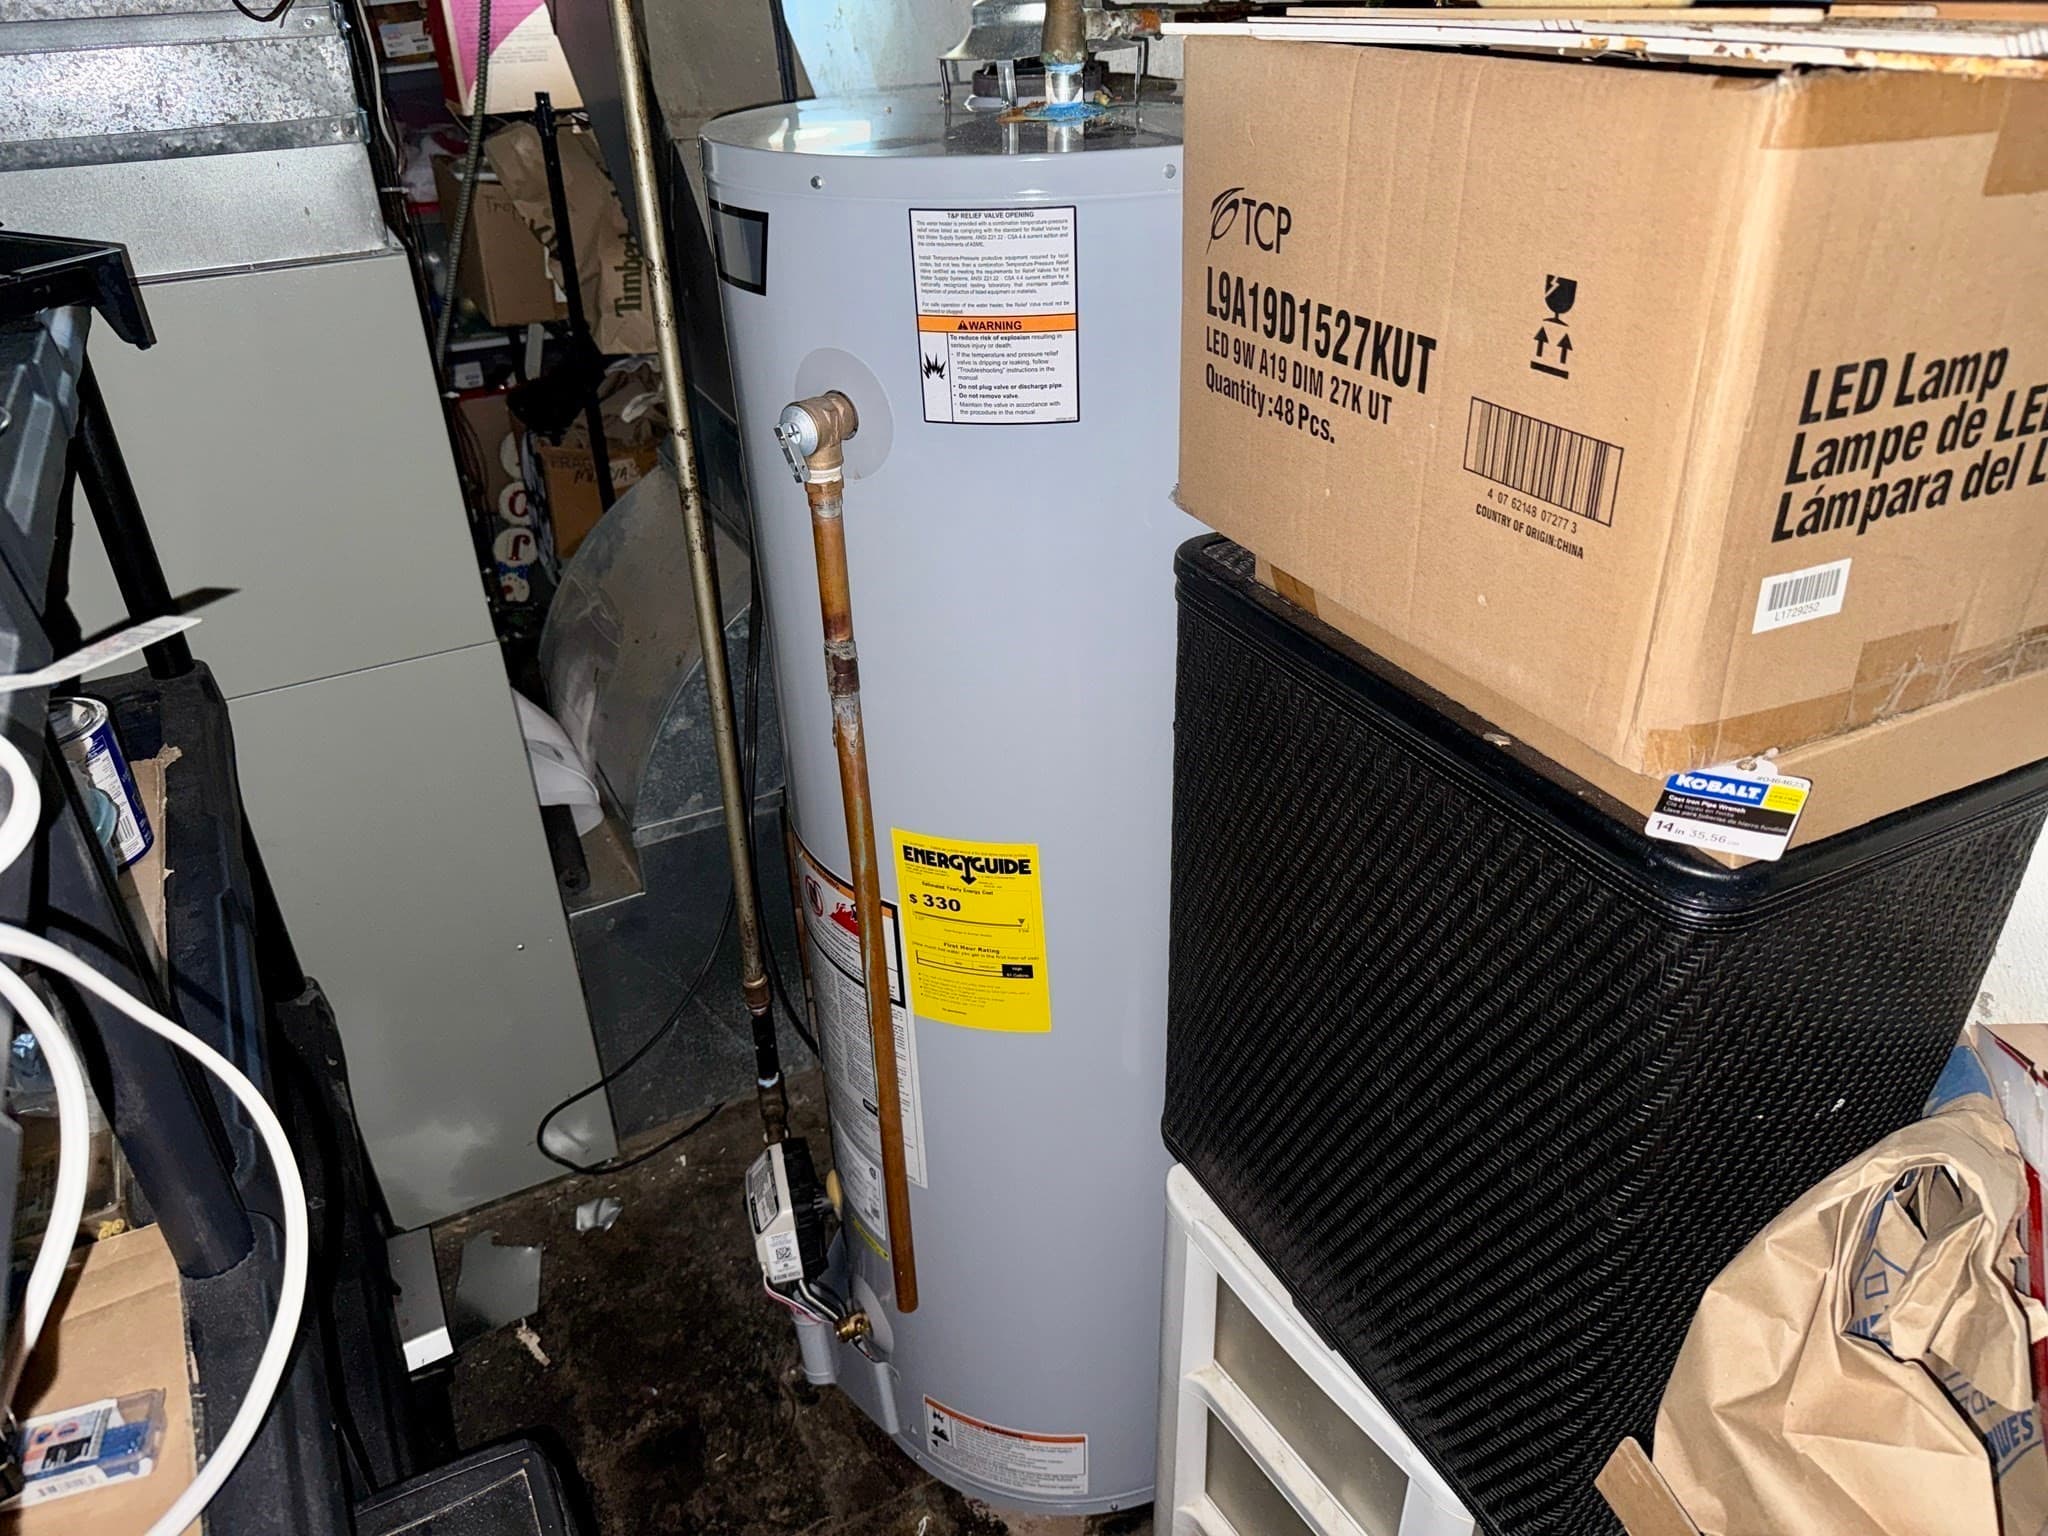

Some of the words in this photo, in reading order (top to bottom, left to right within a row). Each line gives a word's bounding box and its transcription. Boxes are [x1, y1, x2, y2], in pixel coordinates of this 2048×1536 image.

[1241, 197, 1292, 254] TCP
[969, 320, 1022, 331] WARNING
[1206, 266, 1437, 395] L9A19D1527KUT
[1206, 326, 1229, 359] LED
[1233, 338, 1256, 370] 9W
[1259, 348, 1287, 384] A19
[1292, 360, 1324, 399] DIM
[1329, 375, 1363, 415] 27K
[1368, 389, 1392, 425] UT
[1798, 358, 1888, 426] LED
[1893, 346, 2009, 408] Lamp
[1298, 402, 1335, 444] Pcs.
[1784, 420, 1928, 486] Lampe
[1936, 400, 1987, 455] de
[1487, 488, 1493, 499] 4
[1497, 491, 1508, 505] 07
[1511, 497, 1538, 518] 62148
[1540, 509, 1569, 531] 07277
[1570, 521, 1577, 534] 3
[1771, 469, 1953, 543] Lámpara
[1960, 441, 2026, 502] del
[2027, 437, 2048, 486] L
[1475, 503, 1512, 528] COUNTRY
[1513, 519, 1525, 533] OF
[1525, 524, 1584, 560] ORIGIN:CHINA
[1675, 774, 1762, 800] KOBALT
[1656, 820, 1674, 832] 14
[902, 845, 1032, 877] ENERGYGUIDE
[909, 893, 918, 904] $
[922, 894, 961, 912] 330
[977, 947, 1000, 955] Rating
